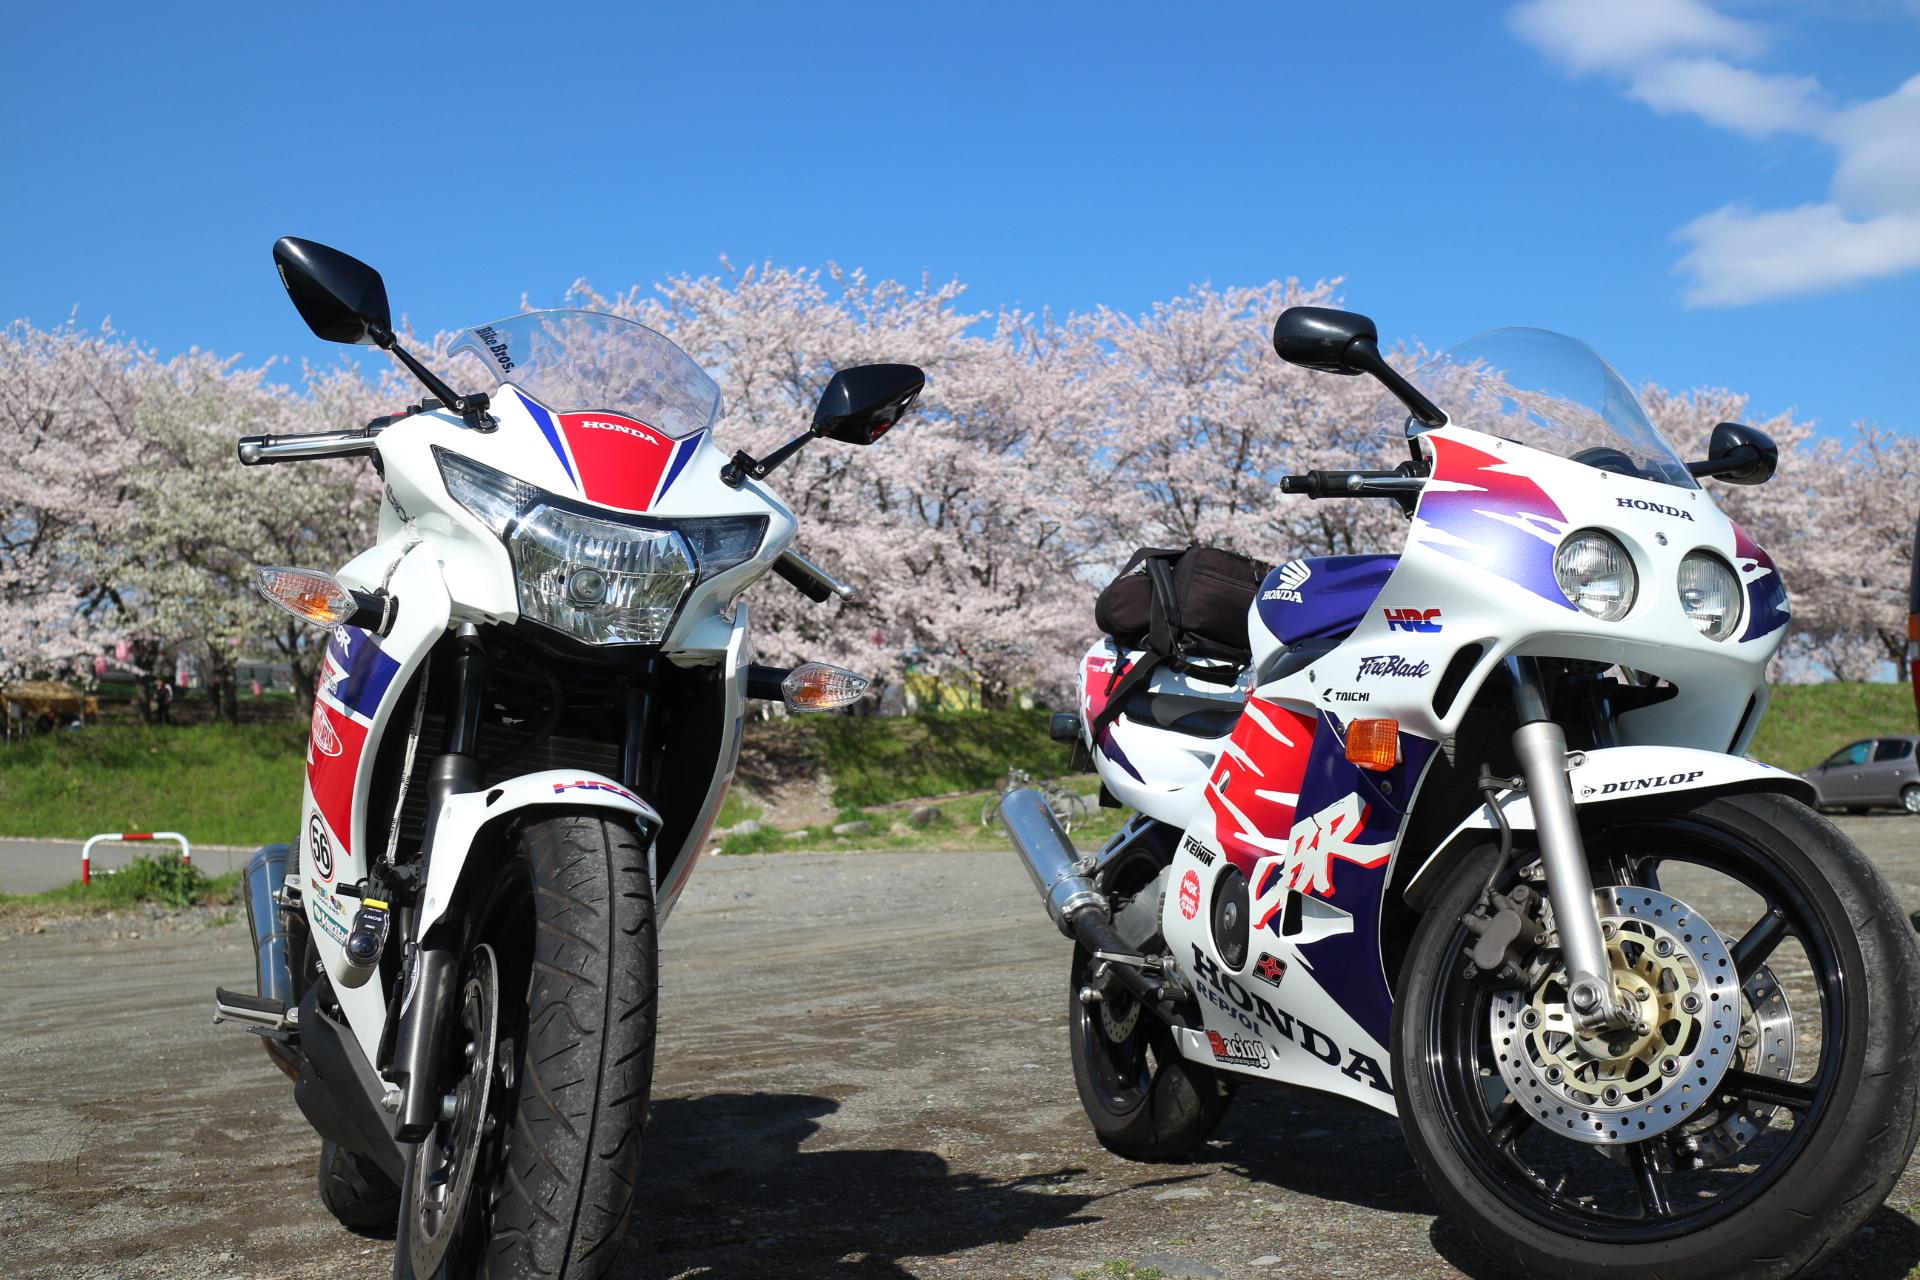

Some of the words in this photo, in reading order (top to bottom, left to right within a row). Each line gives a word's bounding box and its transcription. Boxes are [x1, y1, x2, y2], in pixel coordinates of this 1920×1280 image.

[475, 326, 497, 346] Bike
[490, 343, 515, 374] Bros.
[581, 420, 660, 446] HONDA
[1616, 497, 1695, 522] HONDA
[1261, 590, 1303, 603] HONDA
[1384, 608, 1443, 633] HRC
[1356, 655, 1431, 682] FireBlade
[1335, 692, 1370, 702] TAICHI
[1600, 770, 1703, 795] DUNLOP
[311, 825, 330, 871] 56
[1183, 835, 1217, 867] KEIHIN
[1183, 879, 1198, 896] NGK
[1191, 942, 1394, 1096] HONDA
[1196, 979, 1263, 1037] REPSOL
